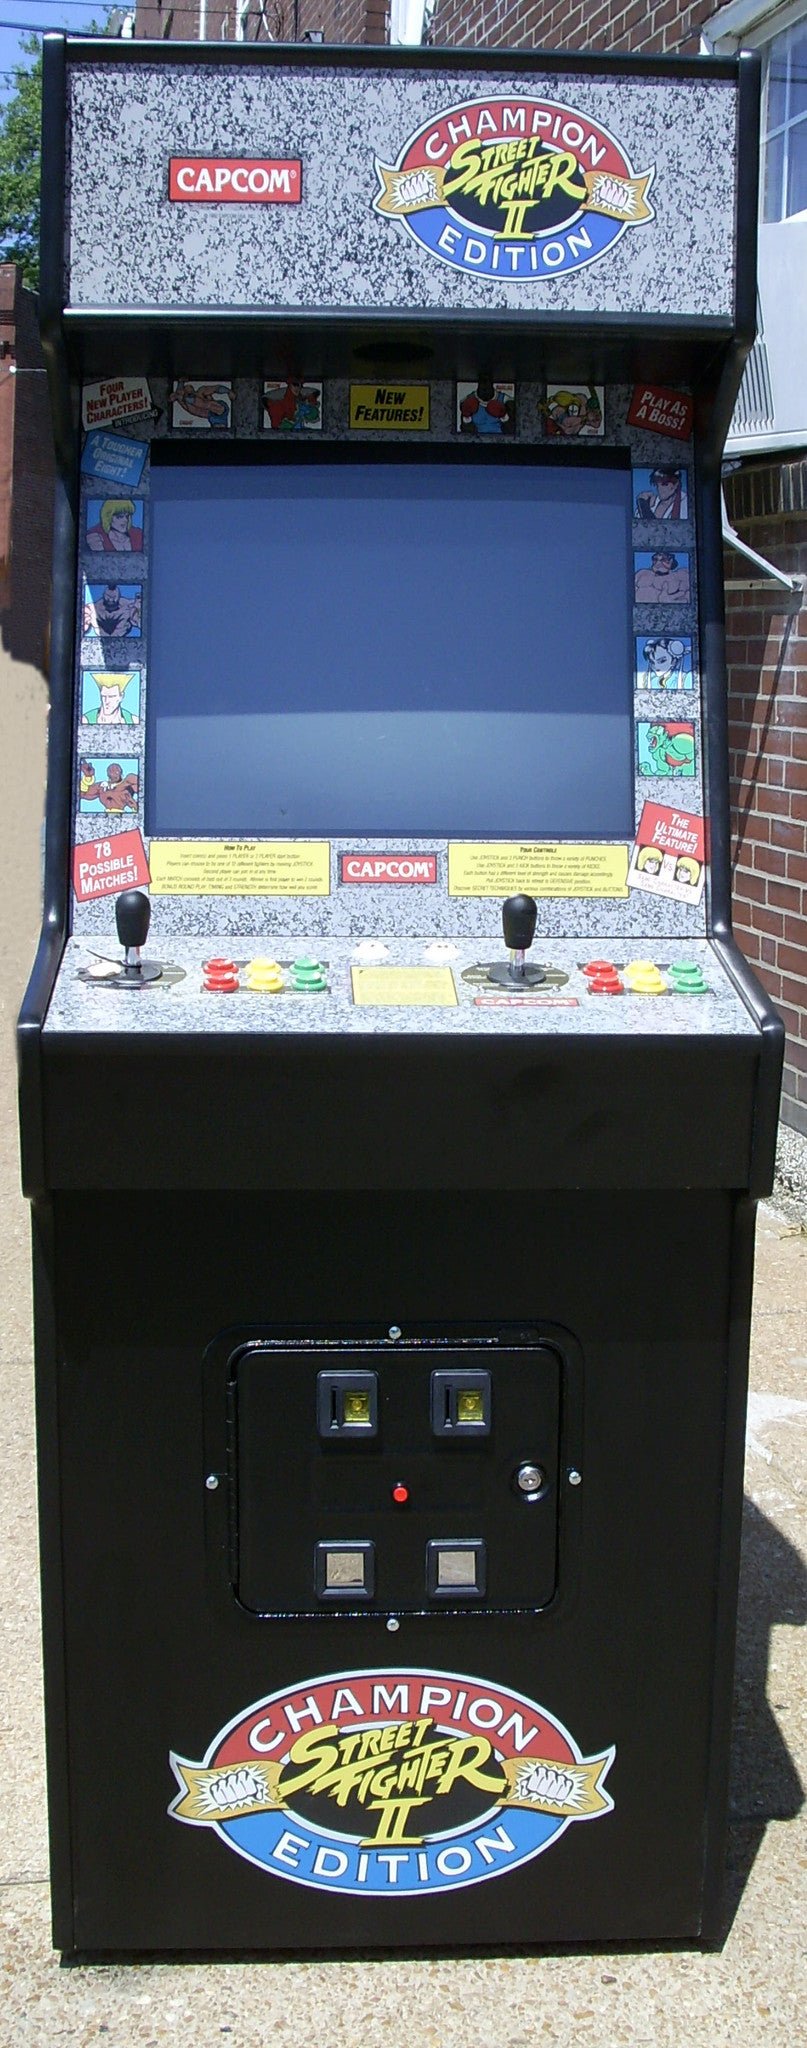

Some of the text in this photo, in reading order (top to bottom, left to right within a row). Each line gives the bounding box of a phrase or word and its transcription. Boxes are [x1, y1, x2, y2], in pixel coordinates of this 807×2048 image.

[425, 108, 607, 166] CHAMPION
[443, 136, 541, 195] STREET
[464, 152, 587, 205] FIGHTER
[493, 200, 540, 240] II
[438, 225, 593, 271] EDITION
[91, 435, 98, 446] A
[636, 410, 646, 420] A
[94, 841, 111, 859] 78
[248, 1684, 539, 1753] CHAMPION
[274, 1718, 434, 1795] STREET
[314, 1736, 507, 1806] FIGHTER
[359, 1797, 433, 1847] II
[272, 1825, 517, 1883] EDITION
